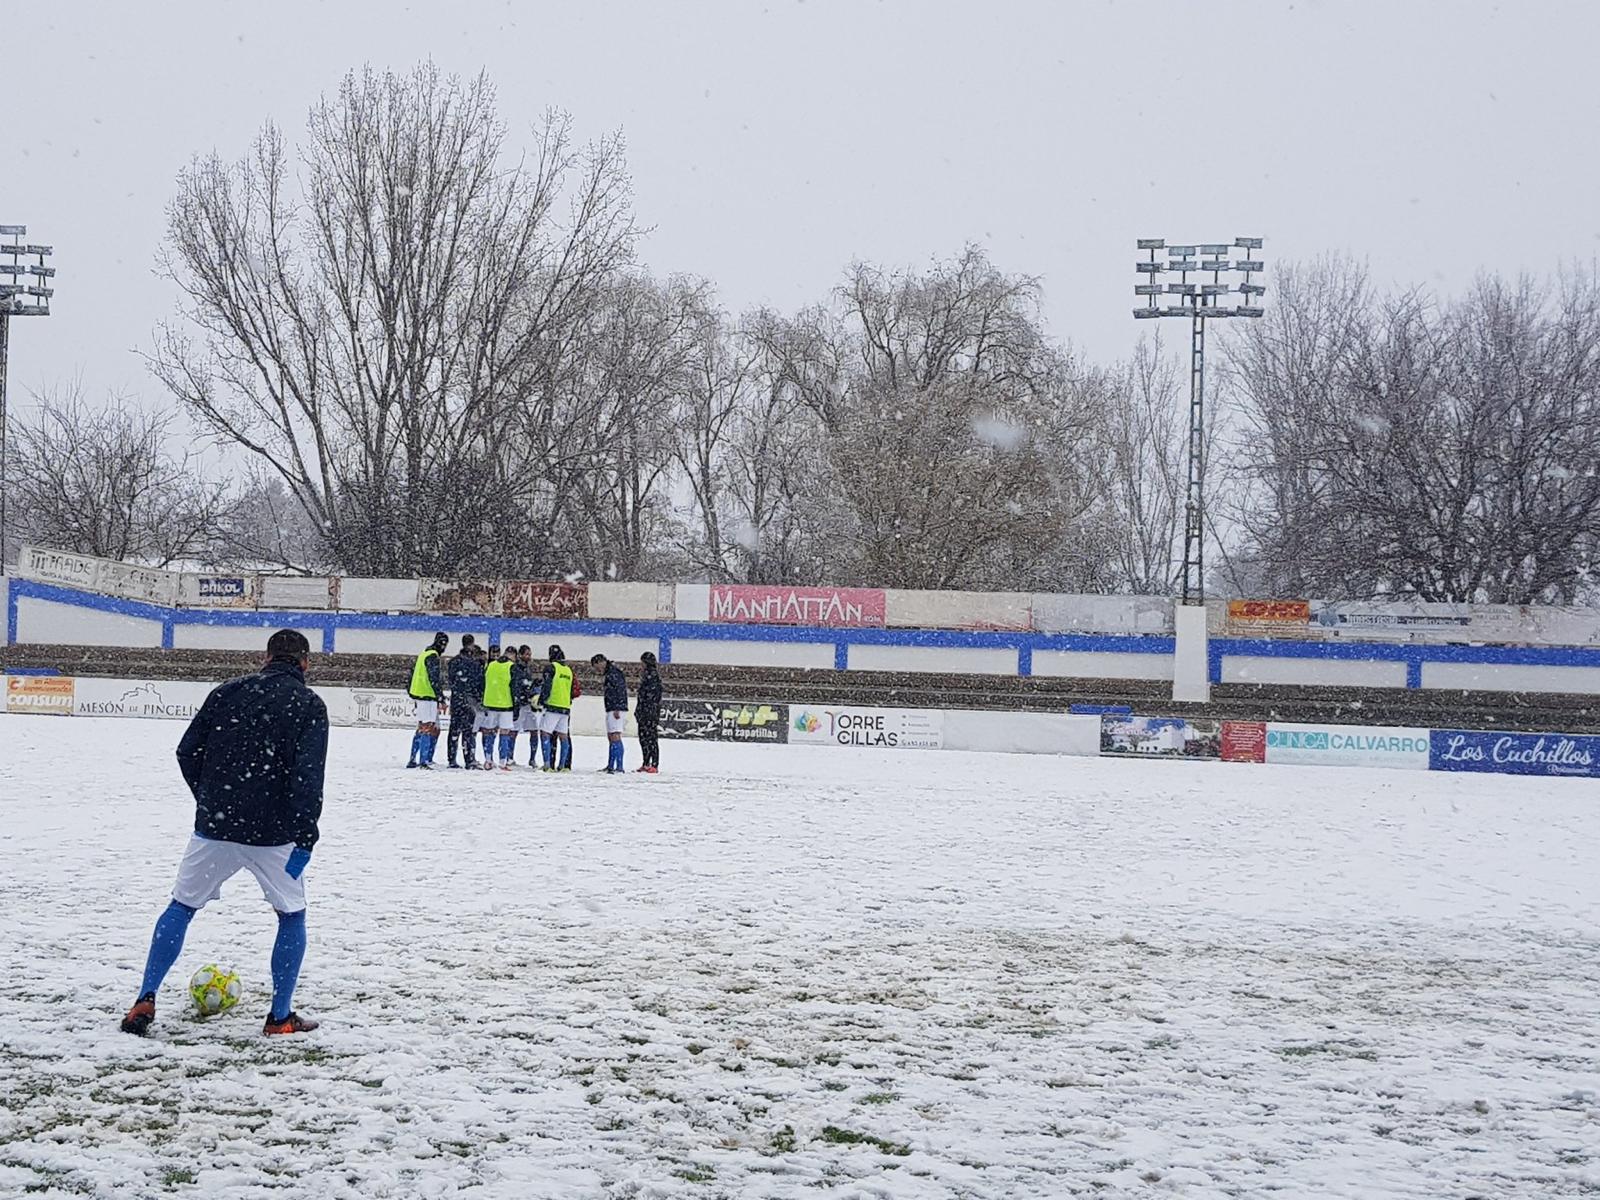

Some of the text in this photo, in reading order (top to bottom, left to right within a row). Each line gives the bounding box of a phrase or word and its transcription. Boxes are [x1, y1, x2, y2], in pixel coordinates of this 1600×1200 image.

[8, 694, 73, 706] consum
[80, 701, 125, 714] MESÓN
[735, 727, 778, 740] zapatillas
[838, 731, 898, 747] CILLAS
[1331, 735, 1428, 753] CALVARRO
[1442, 735, 1593, 765] Los Cuchillos
